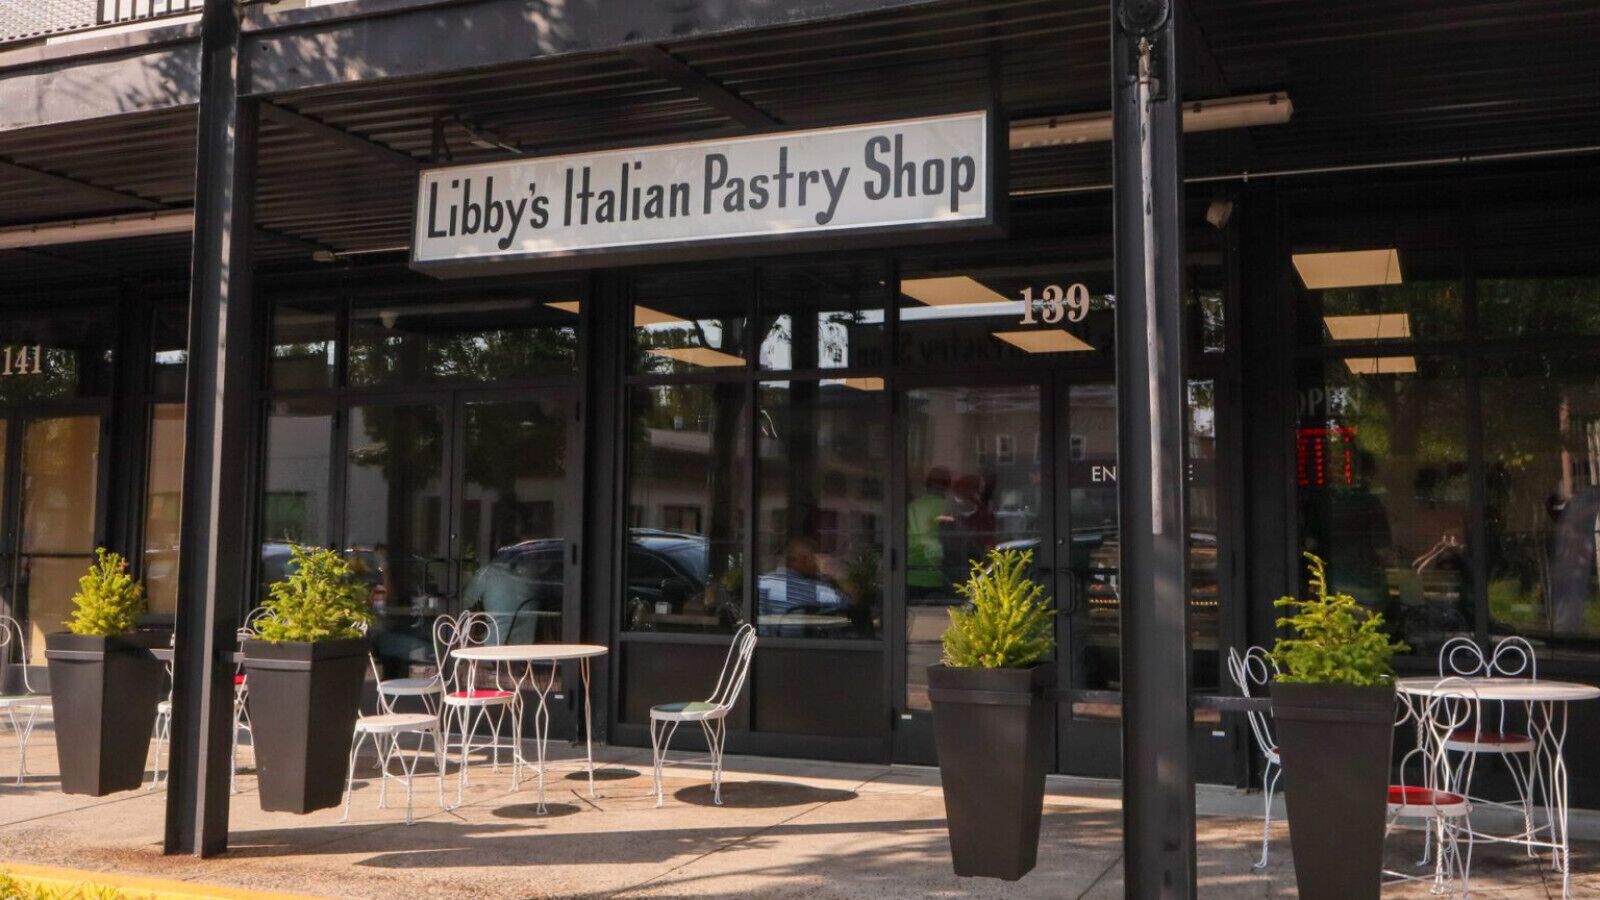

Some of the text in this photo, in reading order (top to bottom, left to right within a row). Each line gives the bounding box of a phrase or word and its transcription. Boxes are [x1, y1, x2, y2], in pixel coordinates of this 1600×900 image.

[427, 133, 976, 250] Libby's Italian Pastry Shop
[1019, 283, 1090, 325] 139
[2, 344, 42, 376] 141
